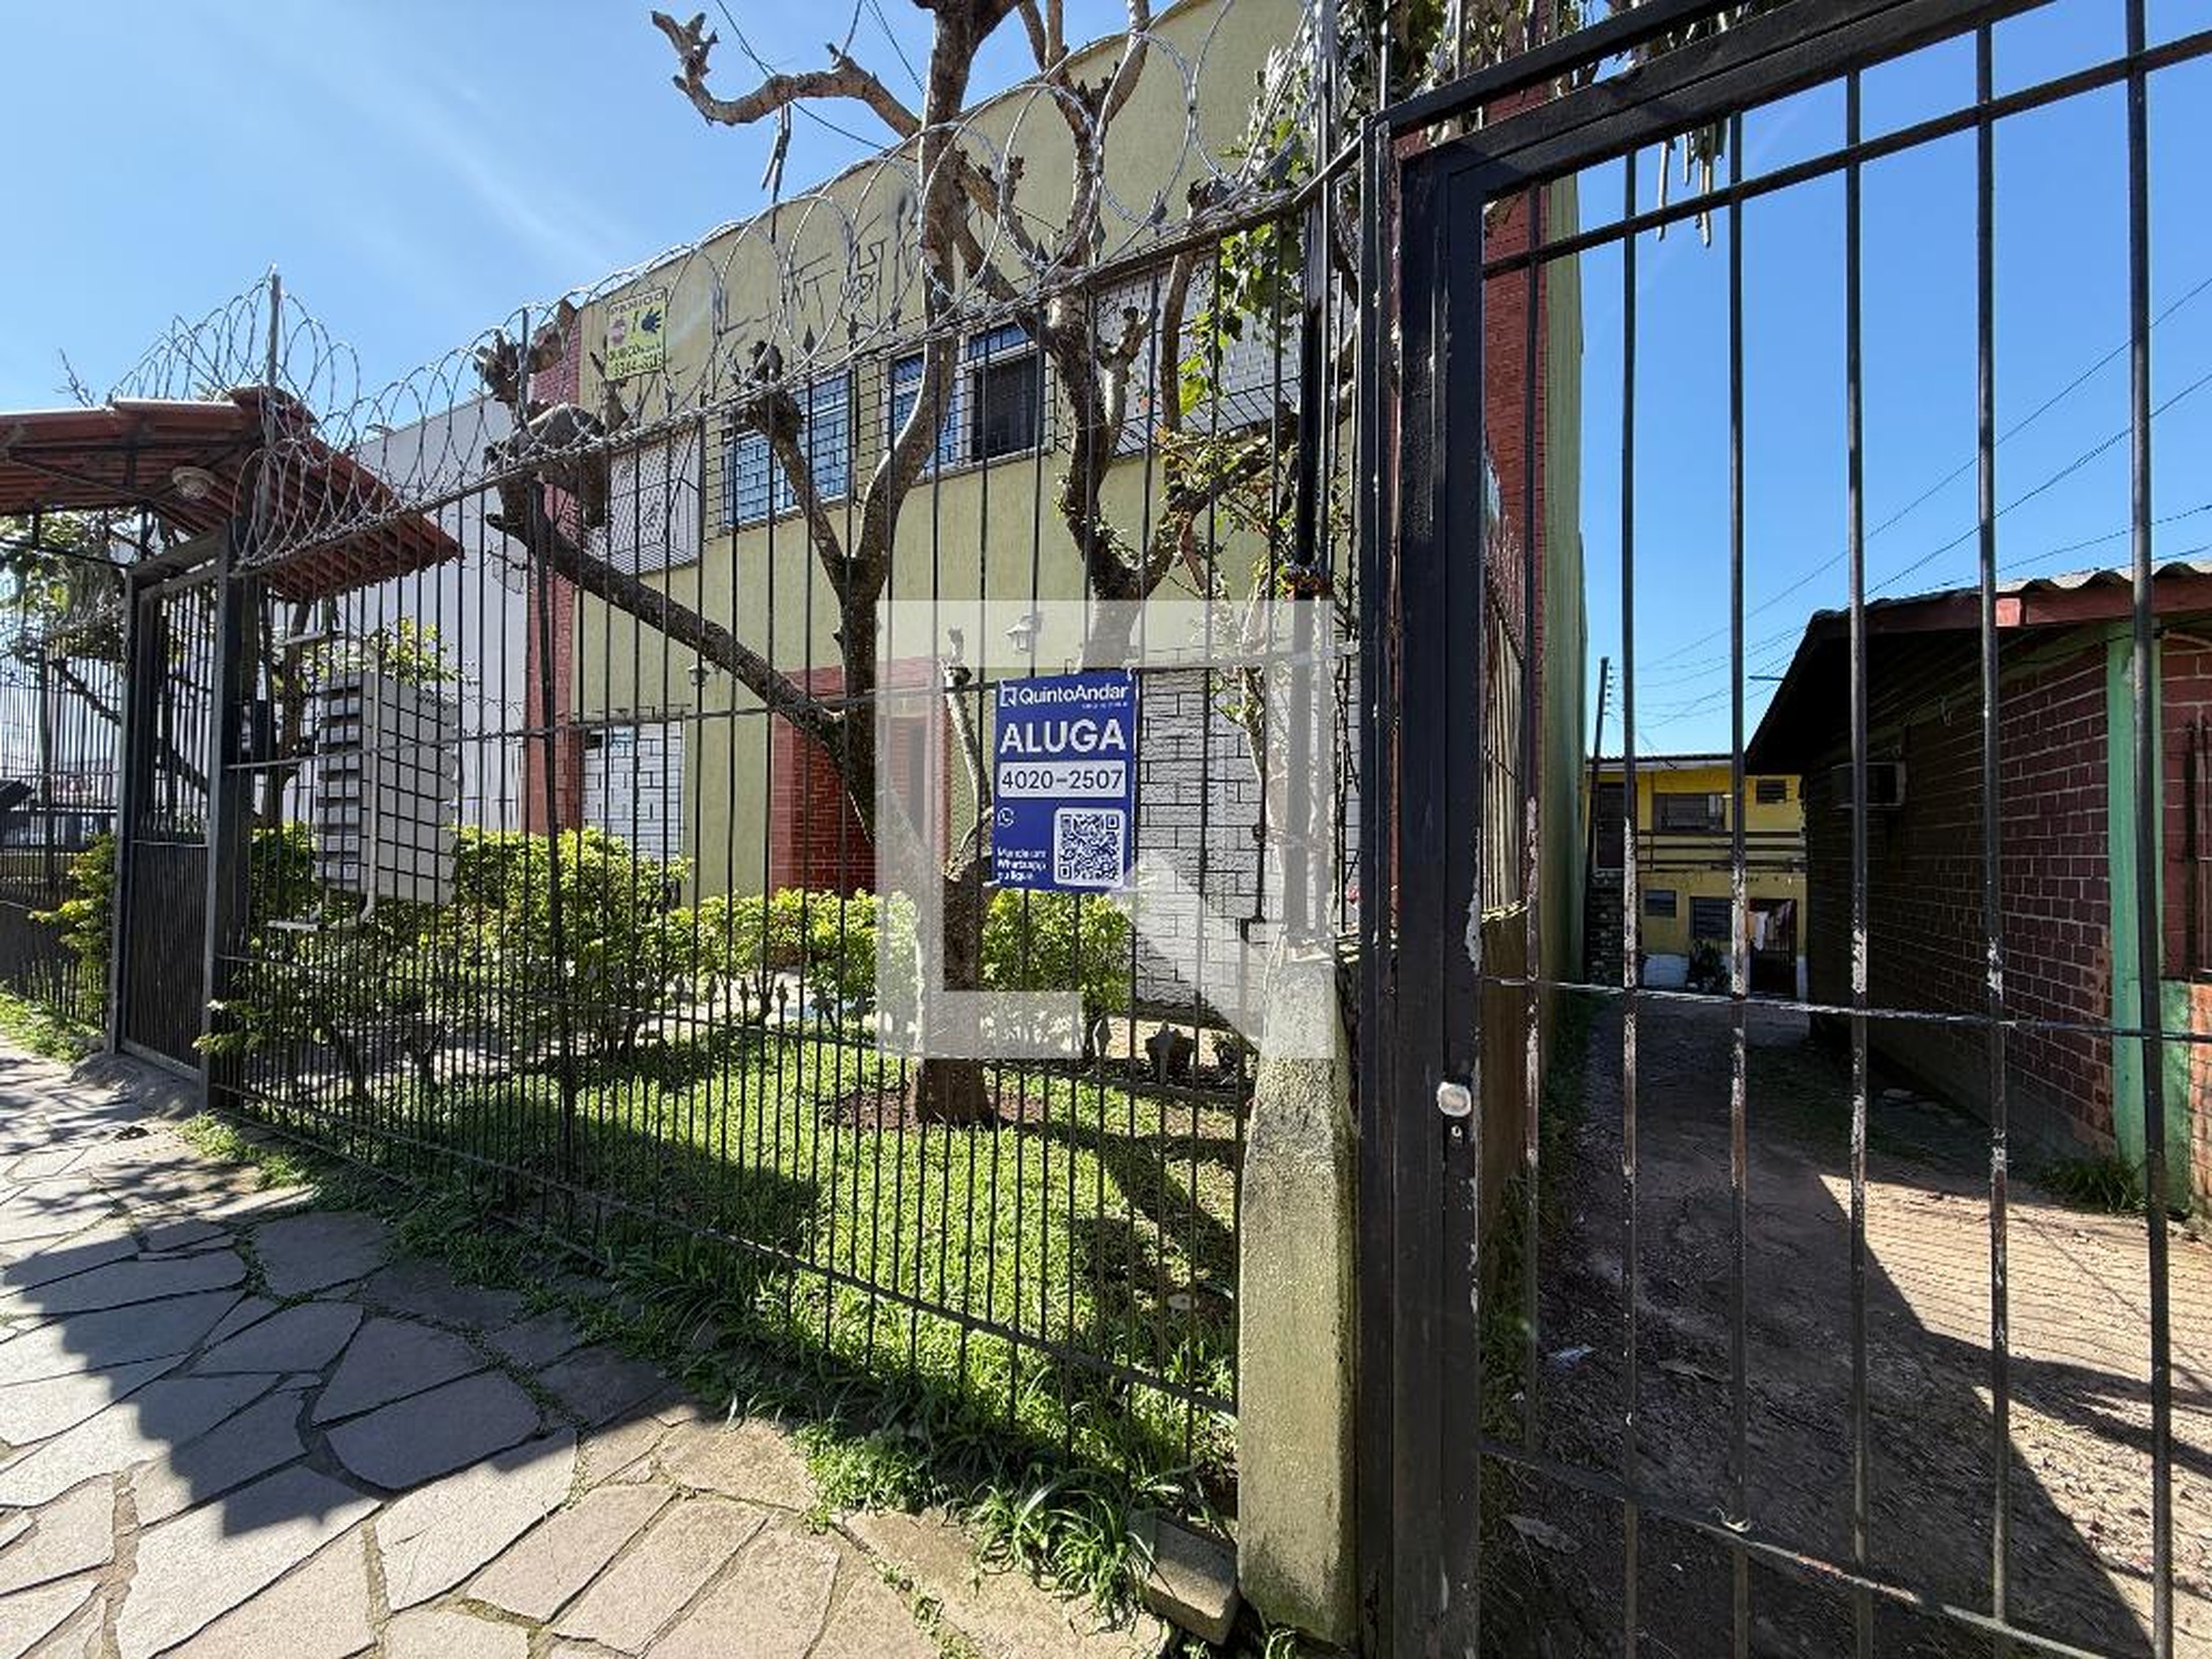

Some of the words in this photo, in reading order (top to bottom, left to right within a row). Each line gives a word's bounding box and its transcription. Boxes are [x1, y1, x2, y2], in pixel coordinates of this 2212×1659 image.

[1019, 683, 1128, 704] QuintoAndar
[999, 718, 1127, 754] ALUGA
[1001, 769, 1124, 790] 4020-2507
